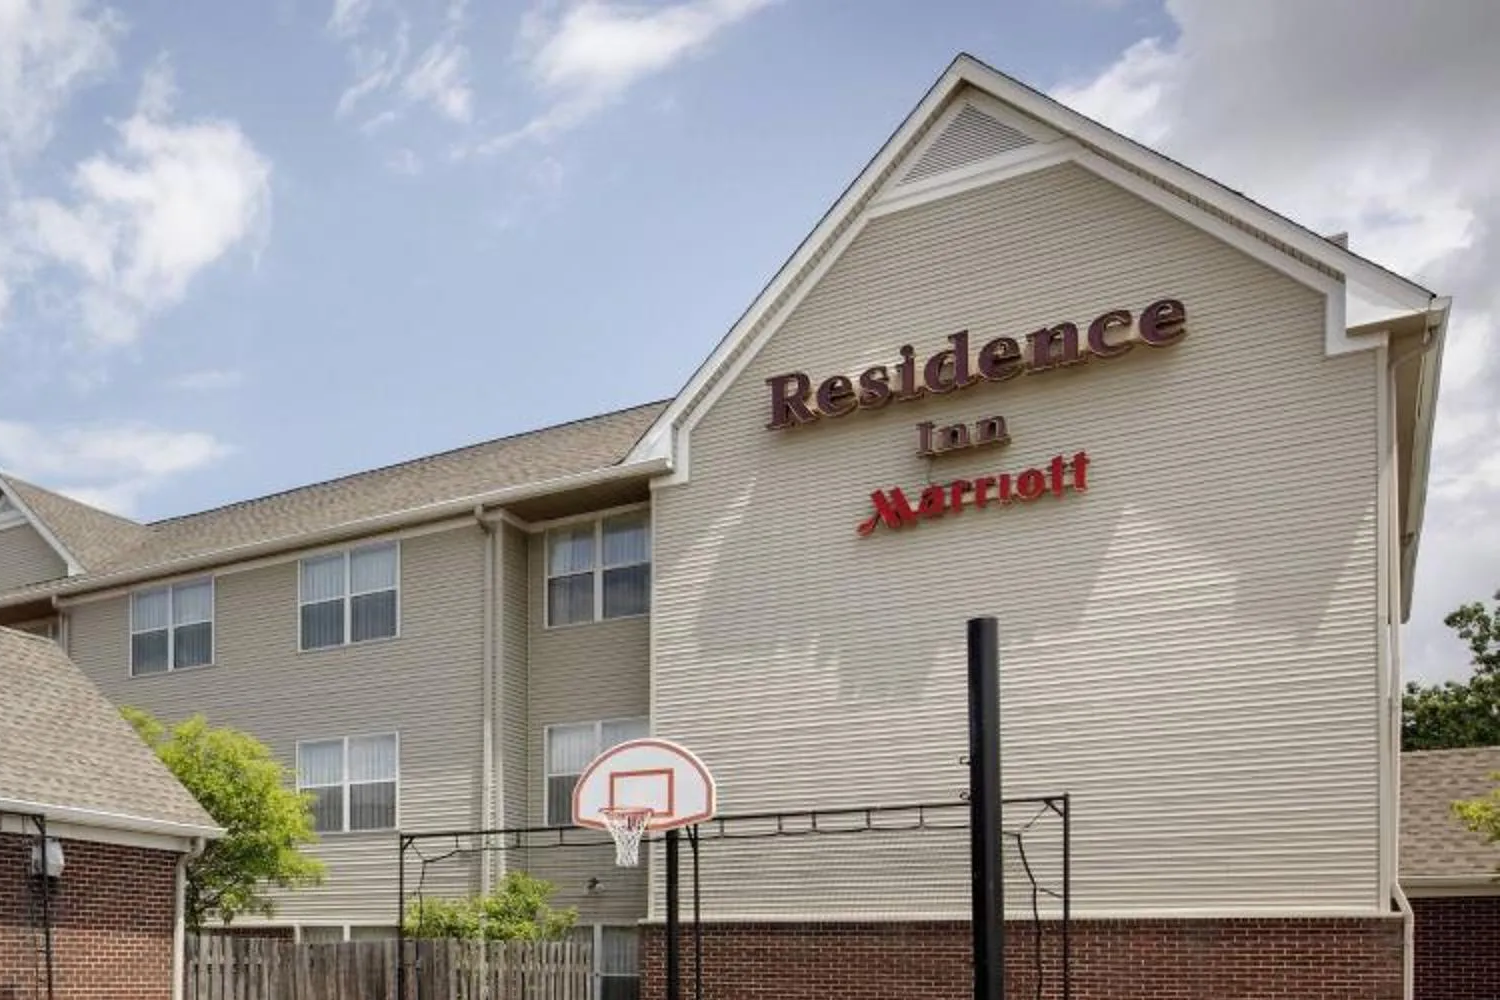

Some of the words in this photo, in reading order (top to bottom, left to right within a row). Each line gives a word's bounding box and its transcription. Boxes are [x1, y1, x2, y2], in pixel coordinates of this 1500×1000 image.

[765, 298, 1188, 430] Residence
[915, 413, 1012, 458] Inn
[855, 450, 1091, 537] Marriott
